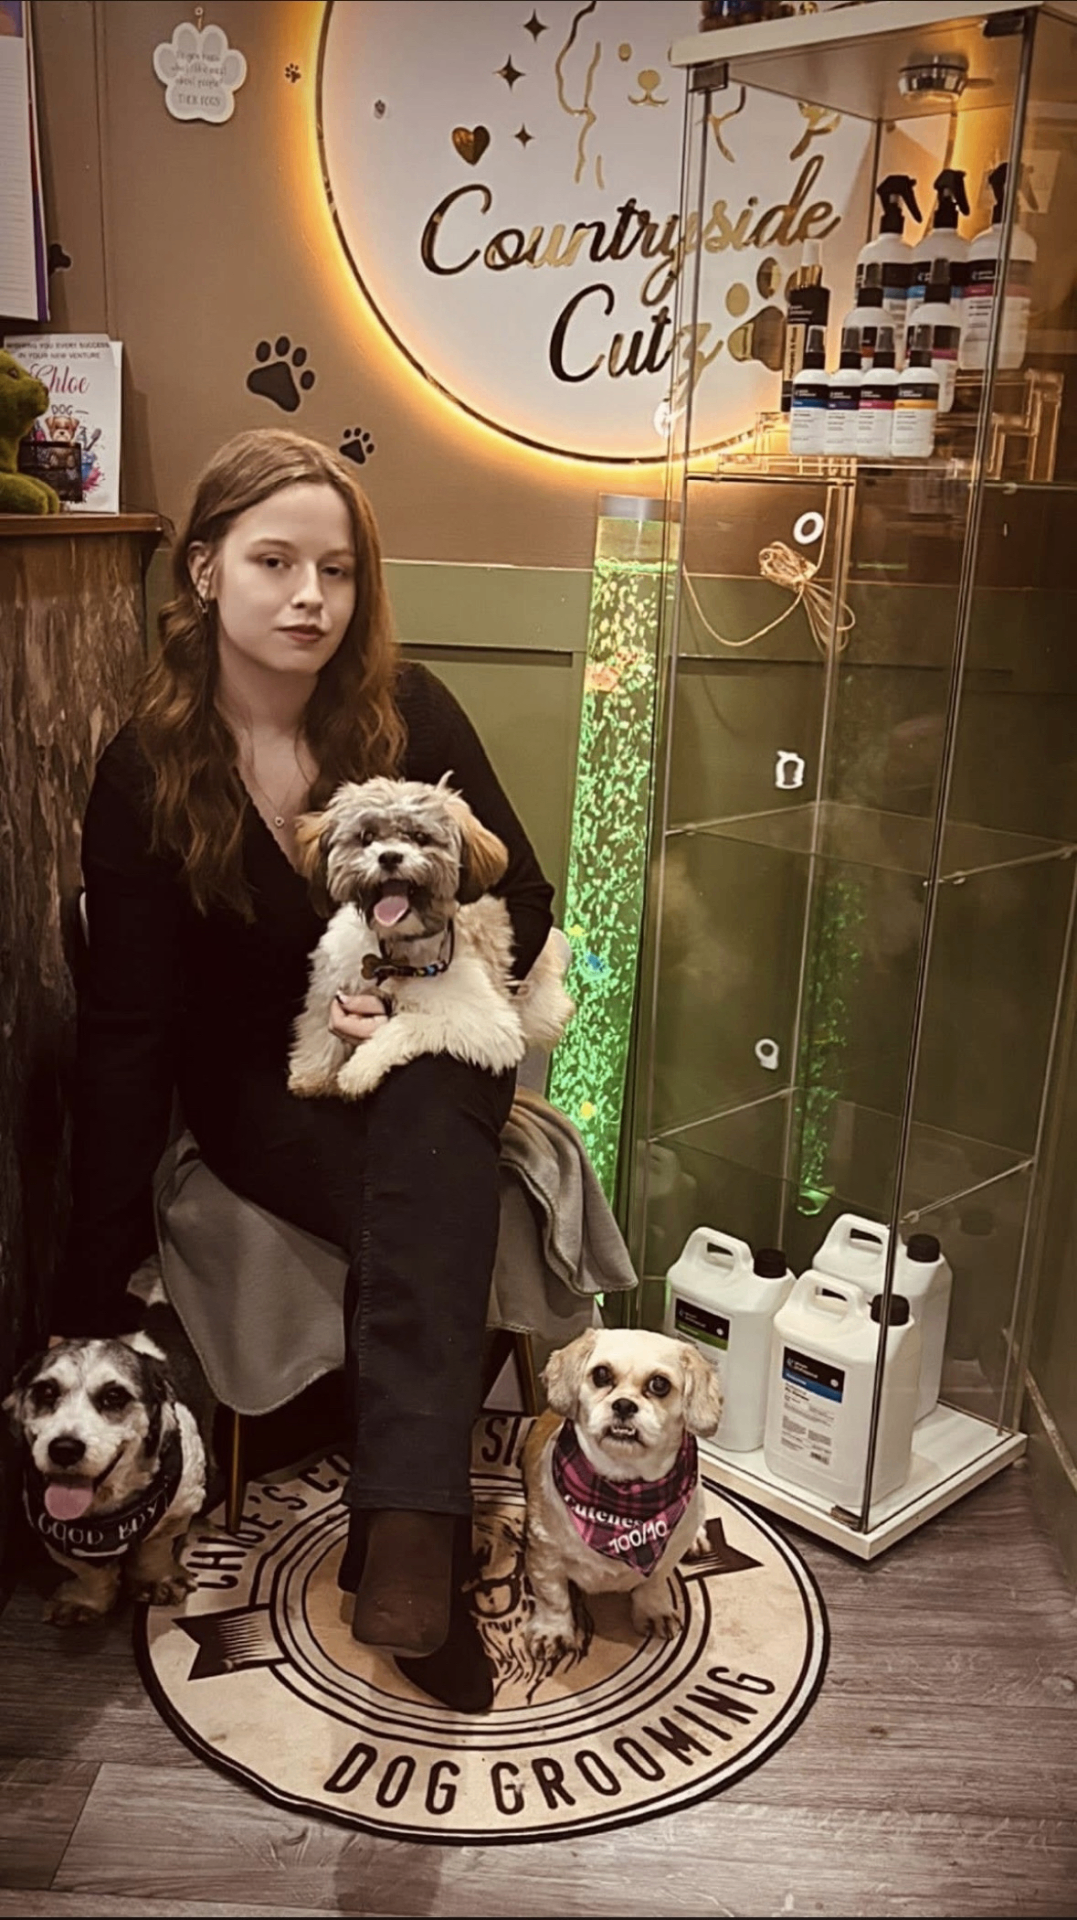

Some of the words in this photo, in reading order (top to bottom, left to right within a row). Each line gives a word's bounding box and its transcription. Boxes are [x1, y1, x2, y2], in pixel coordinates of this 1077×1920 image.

[420, 154, 842, 307] Countryside
[30, 362, 91, 395] Chloe
[549, 283, 724, 438] Cutz
[51, 404, 74, 416] DOG
[38, 1512, 104, 1545] GOOD
[118, 1499, 158, 1540] BOY
[608, 1520, 668, 1554] 100/10
[323, 1741, 461, 1815] DOG
[490, 1665, 776, 1816] GROOMING
